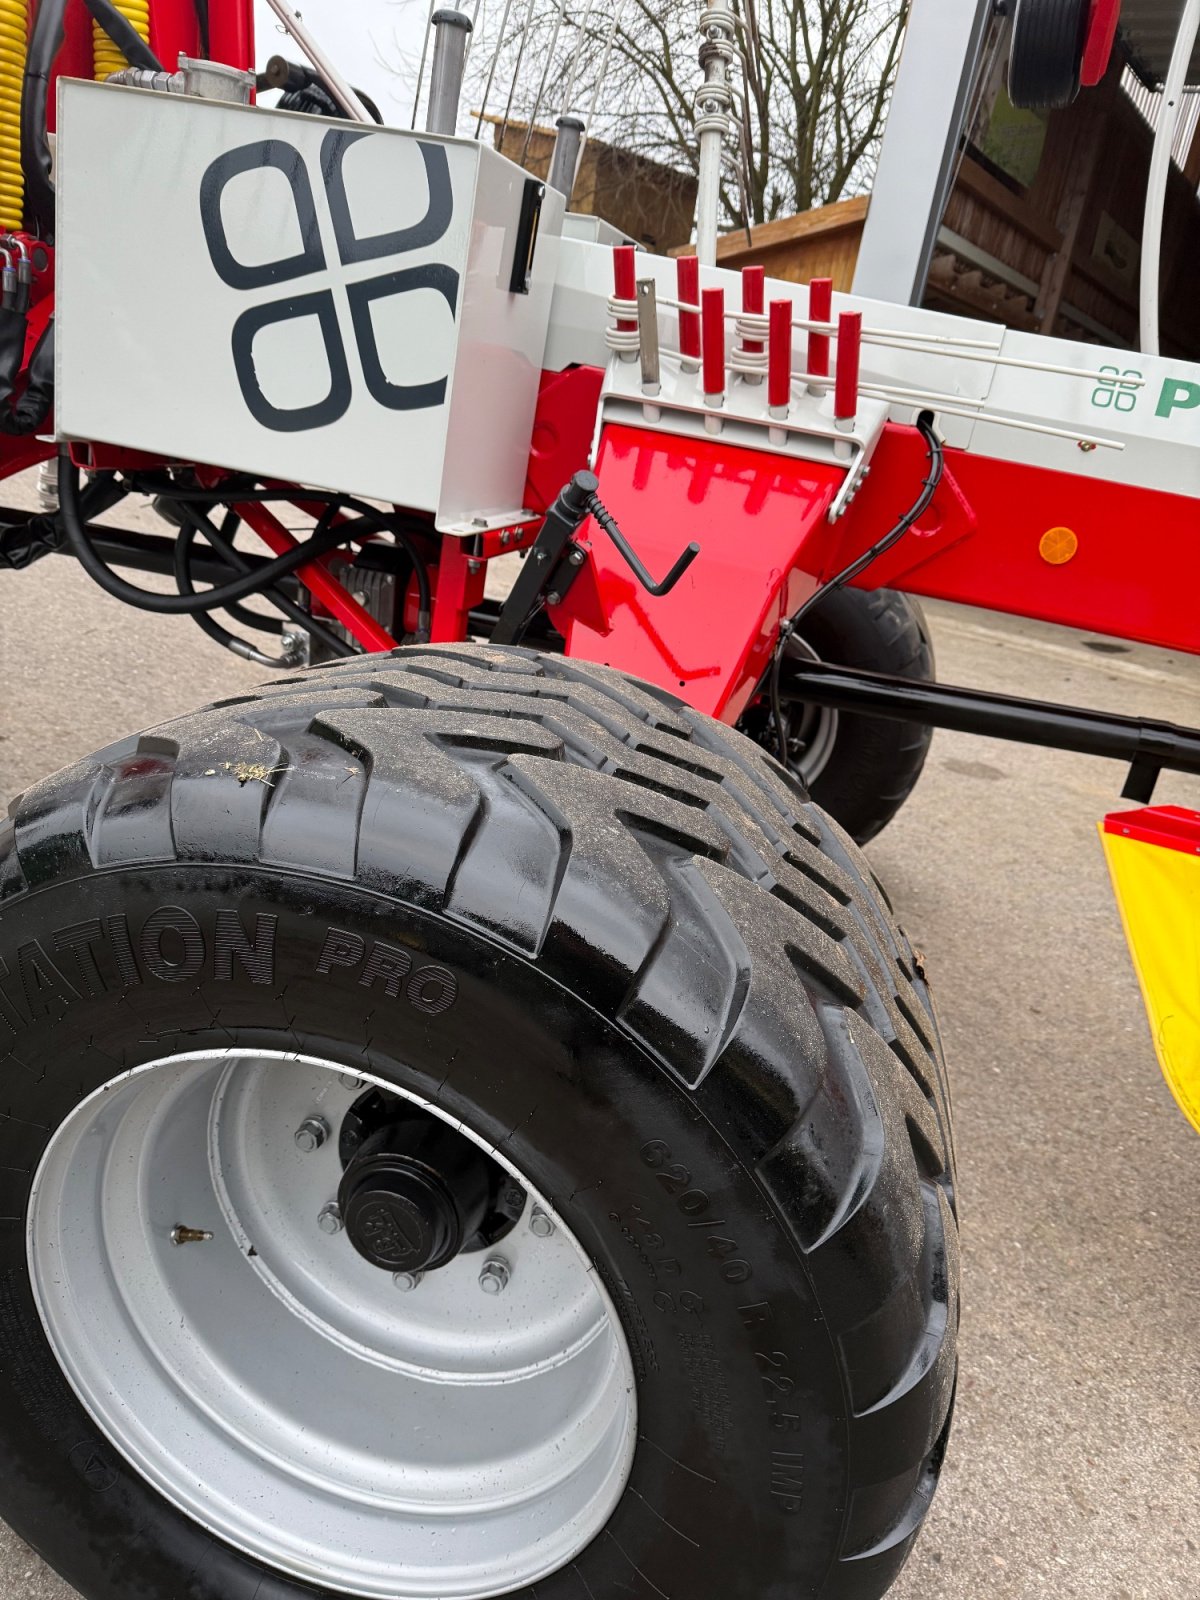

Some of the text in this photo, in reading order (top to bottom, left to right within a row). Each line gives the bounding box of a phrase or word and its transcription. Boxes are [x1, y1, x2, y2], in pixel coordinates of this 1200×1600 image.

[1155, 377, 1200, 418] P
[315, 924, 459, 1017] PRO
[639, 1138, 752, 1284] 620/40
[770, 1451, 806, 1515] IMP
